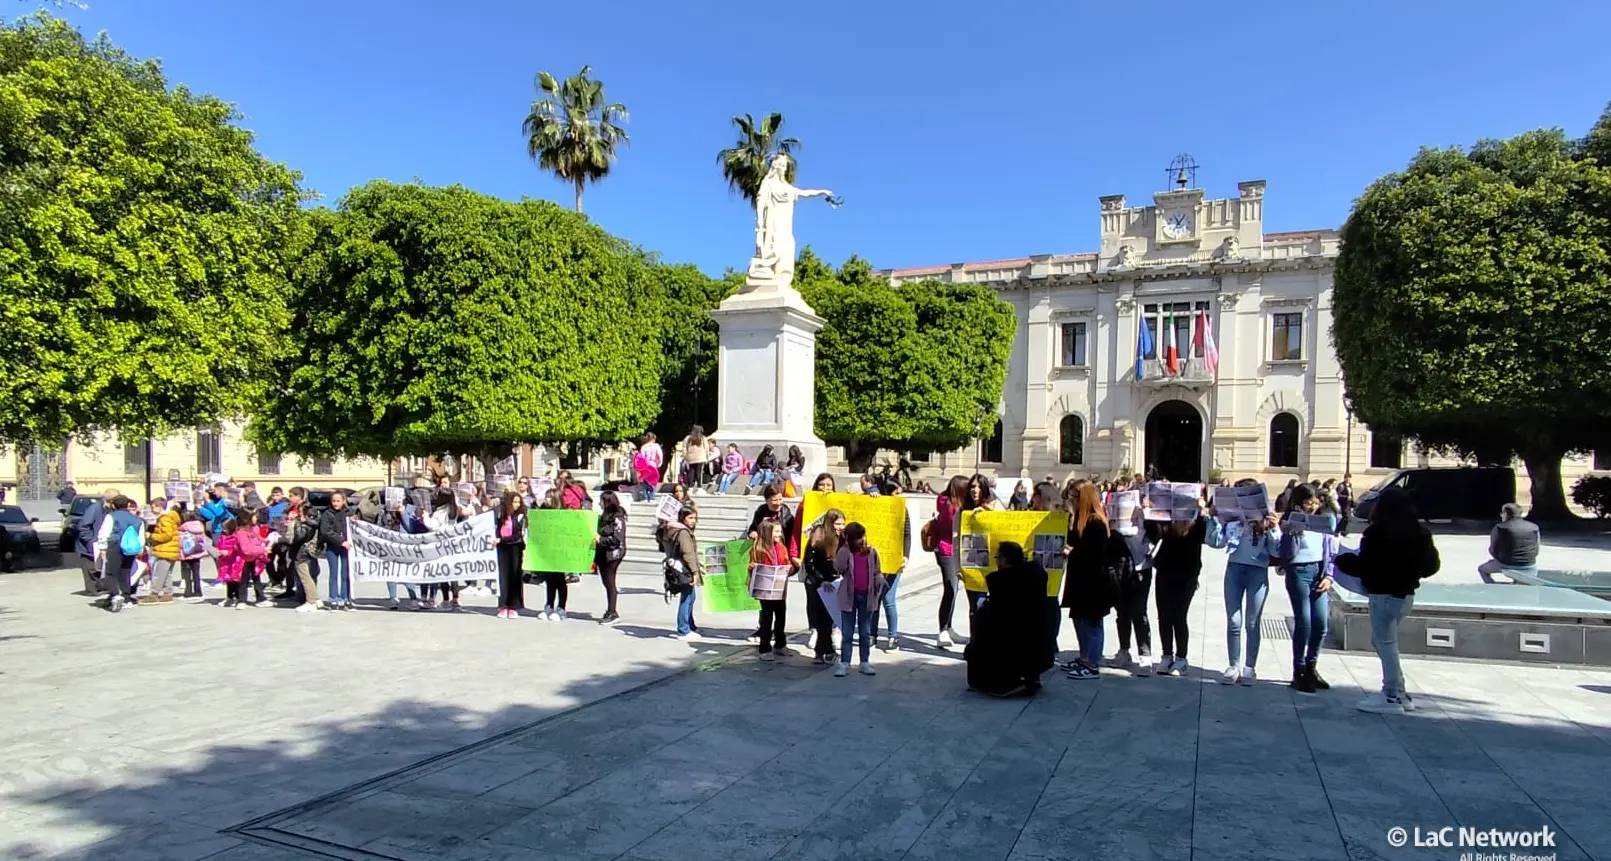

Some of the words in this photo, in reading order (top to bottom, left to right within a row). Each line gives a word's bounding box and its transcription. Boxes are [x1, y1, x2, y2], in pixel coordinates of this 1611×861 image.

[434, 521, 473, 540] ALLA
[435, 534, 495, 556] PRECLUDE
[354, 561, 364, 575] IL
[369, 560, 420, 576] DIRITTO
[423, 563, 450, 578] ALLO
[454, 559, 497, 576] STUDIO
